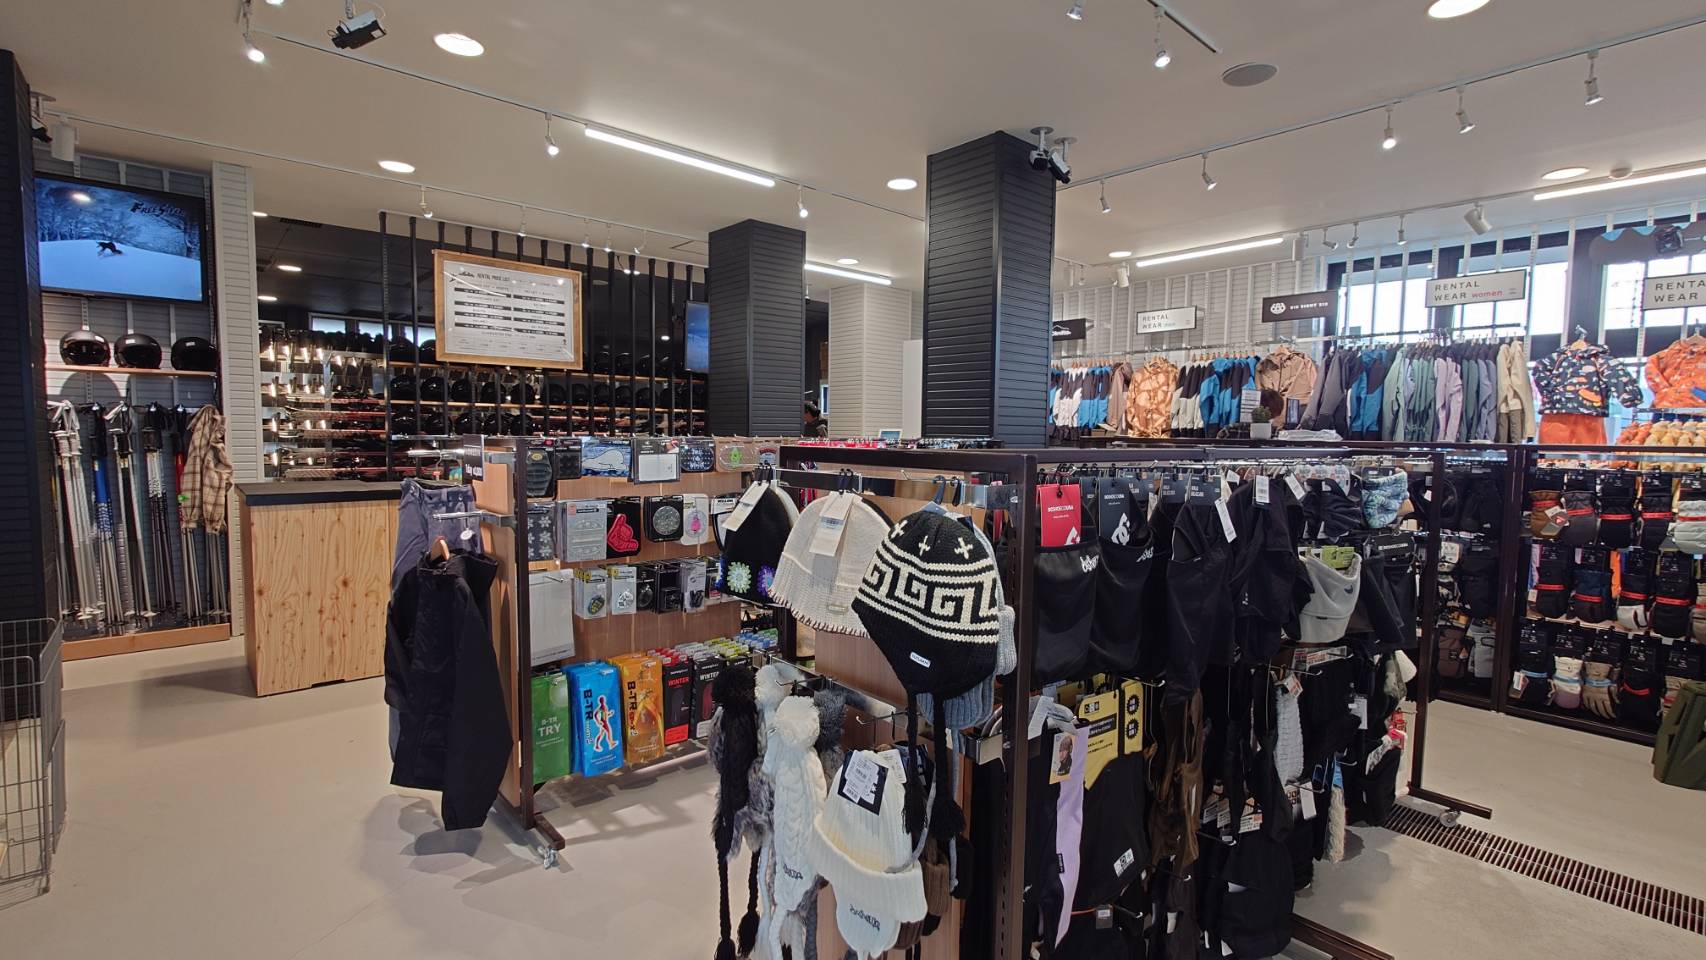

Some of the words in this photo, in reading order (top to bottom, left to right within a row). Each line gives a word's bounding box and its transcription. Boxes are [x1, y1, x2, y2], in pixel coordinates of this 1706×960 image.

[1434, 281, 1480, 291] RENTAL
[1434, 292, 1467, 302] WEAR
[1472, 290, 1504, 299] women
[1653, 292, 1698, 303] WEAR
[1142, 313, 1169, 322] RENTAL
[1142, 322, 1162, 330] WEAR
[627, 680, 638, 711] B-TR
[583, 688, 594, 720] B-TR
[537, 721, 562, 737] TRY
